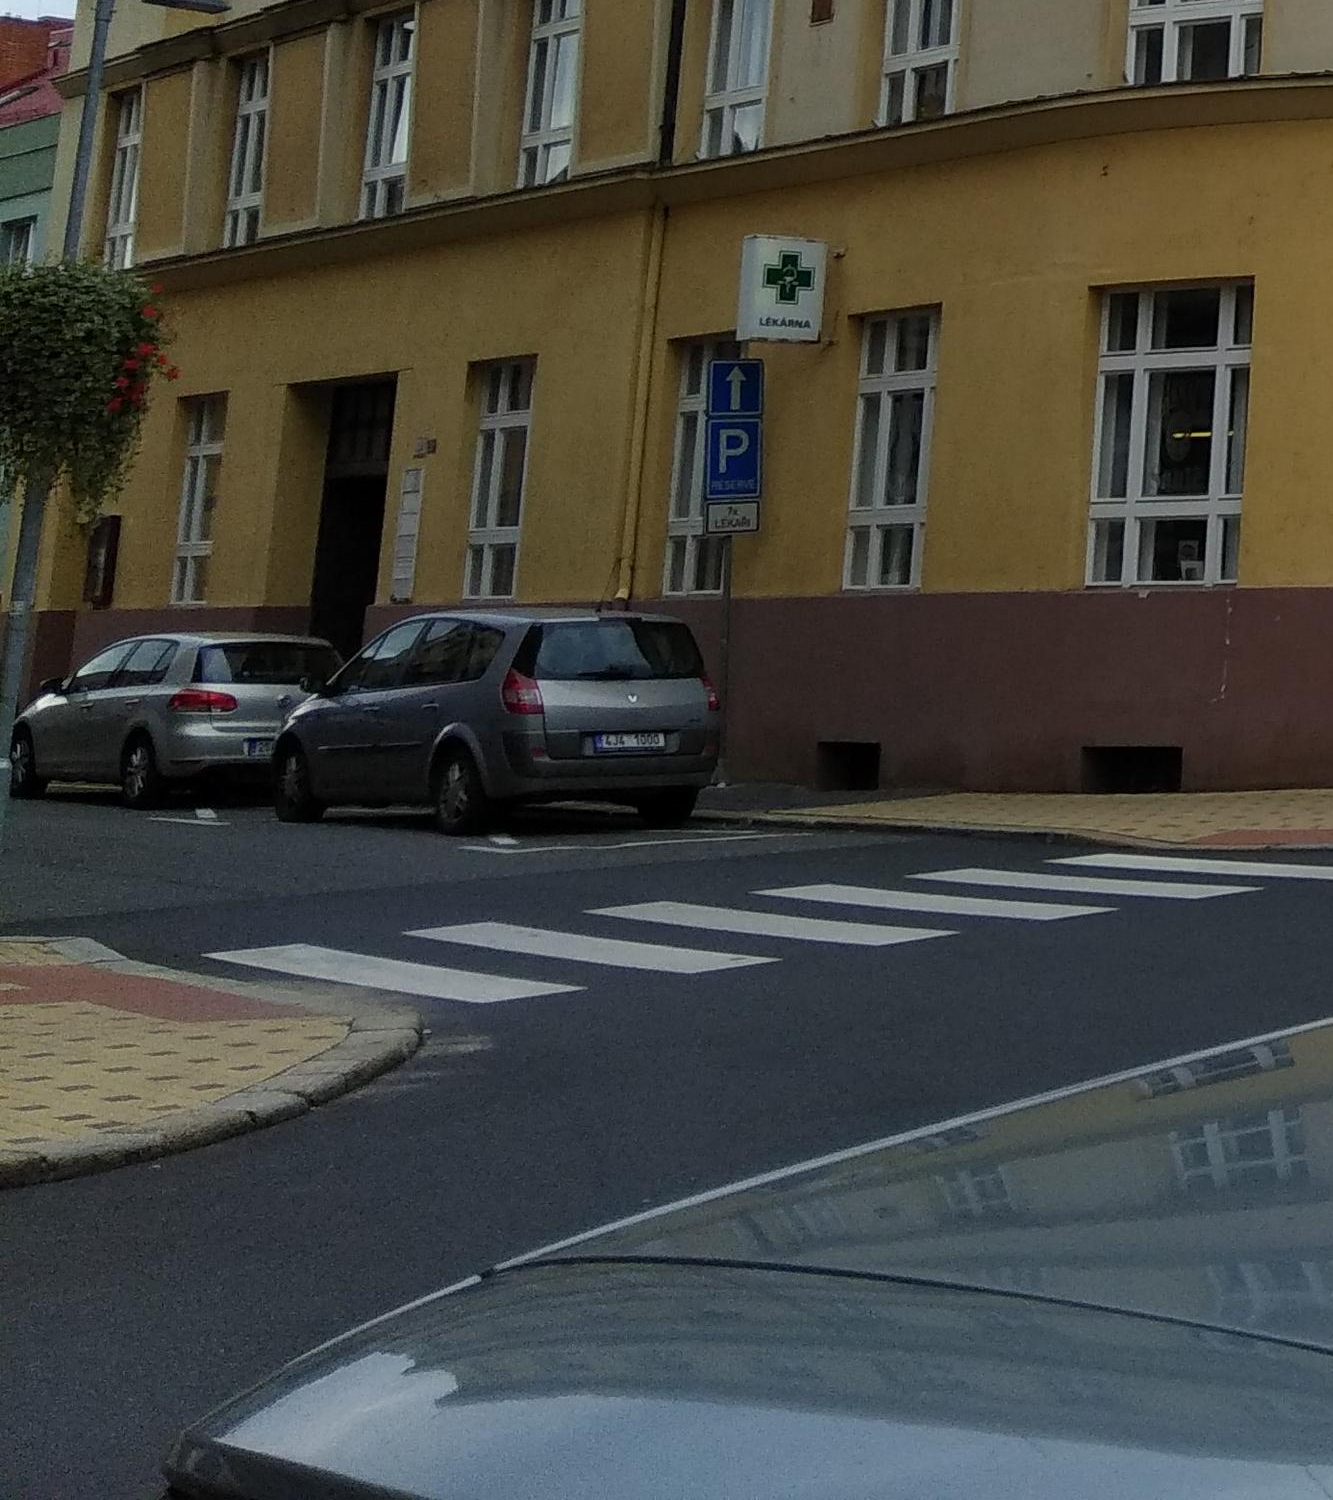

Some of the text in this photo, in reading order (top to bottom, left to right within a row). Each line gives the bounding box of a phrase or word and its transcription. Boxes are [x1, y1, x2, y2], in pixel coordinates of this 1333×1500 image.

[758, 316, 812, 330] LÉKÁRNA
[718, 428, 750, 475] P
[605, 732, 660, 746] 4J4 1000
